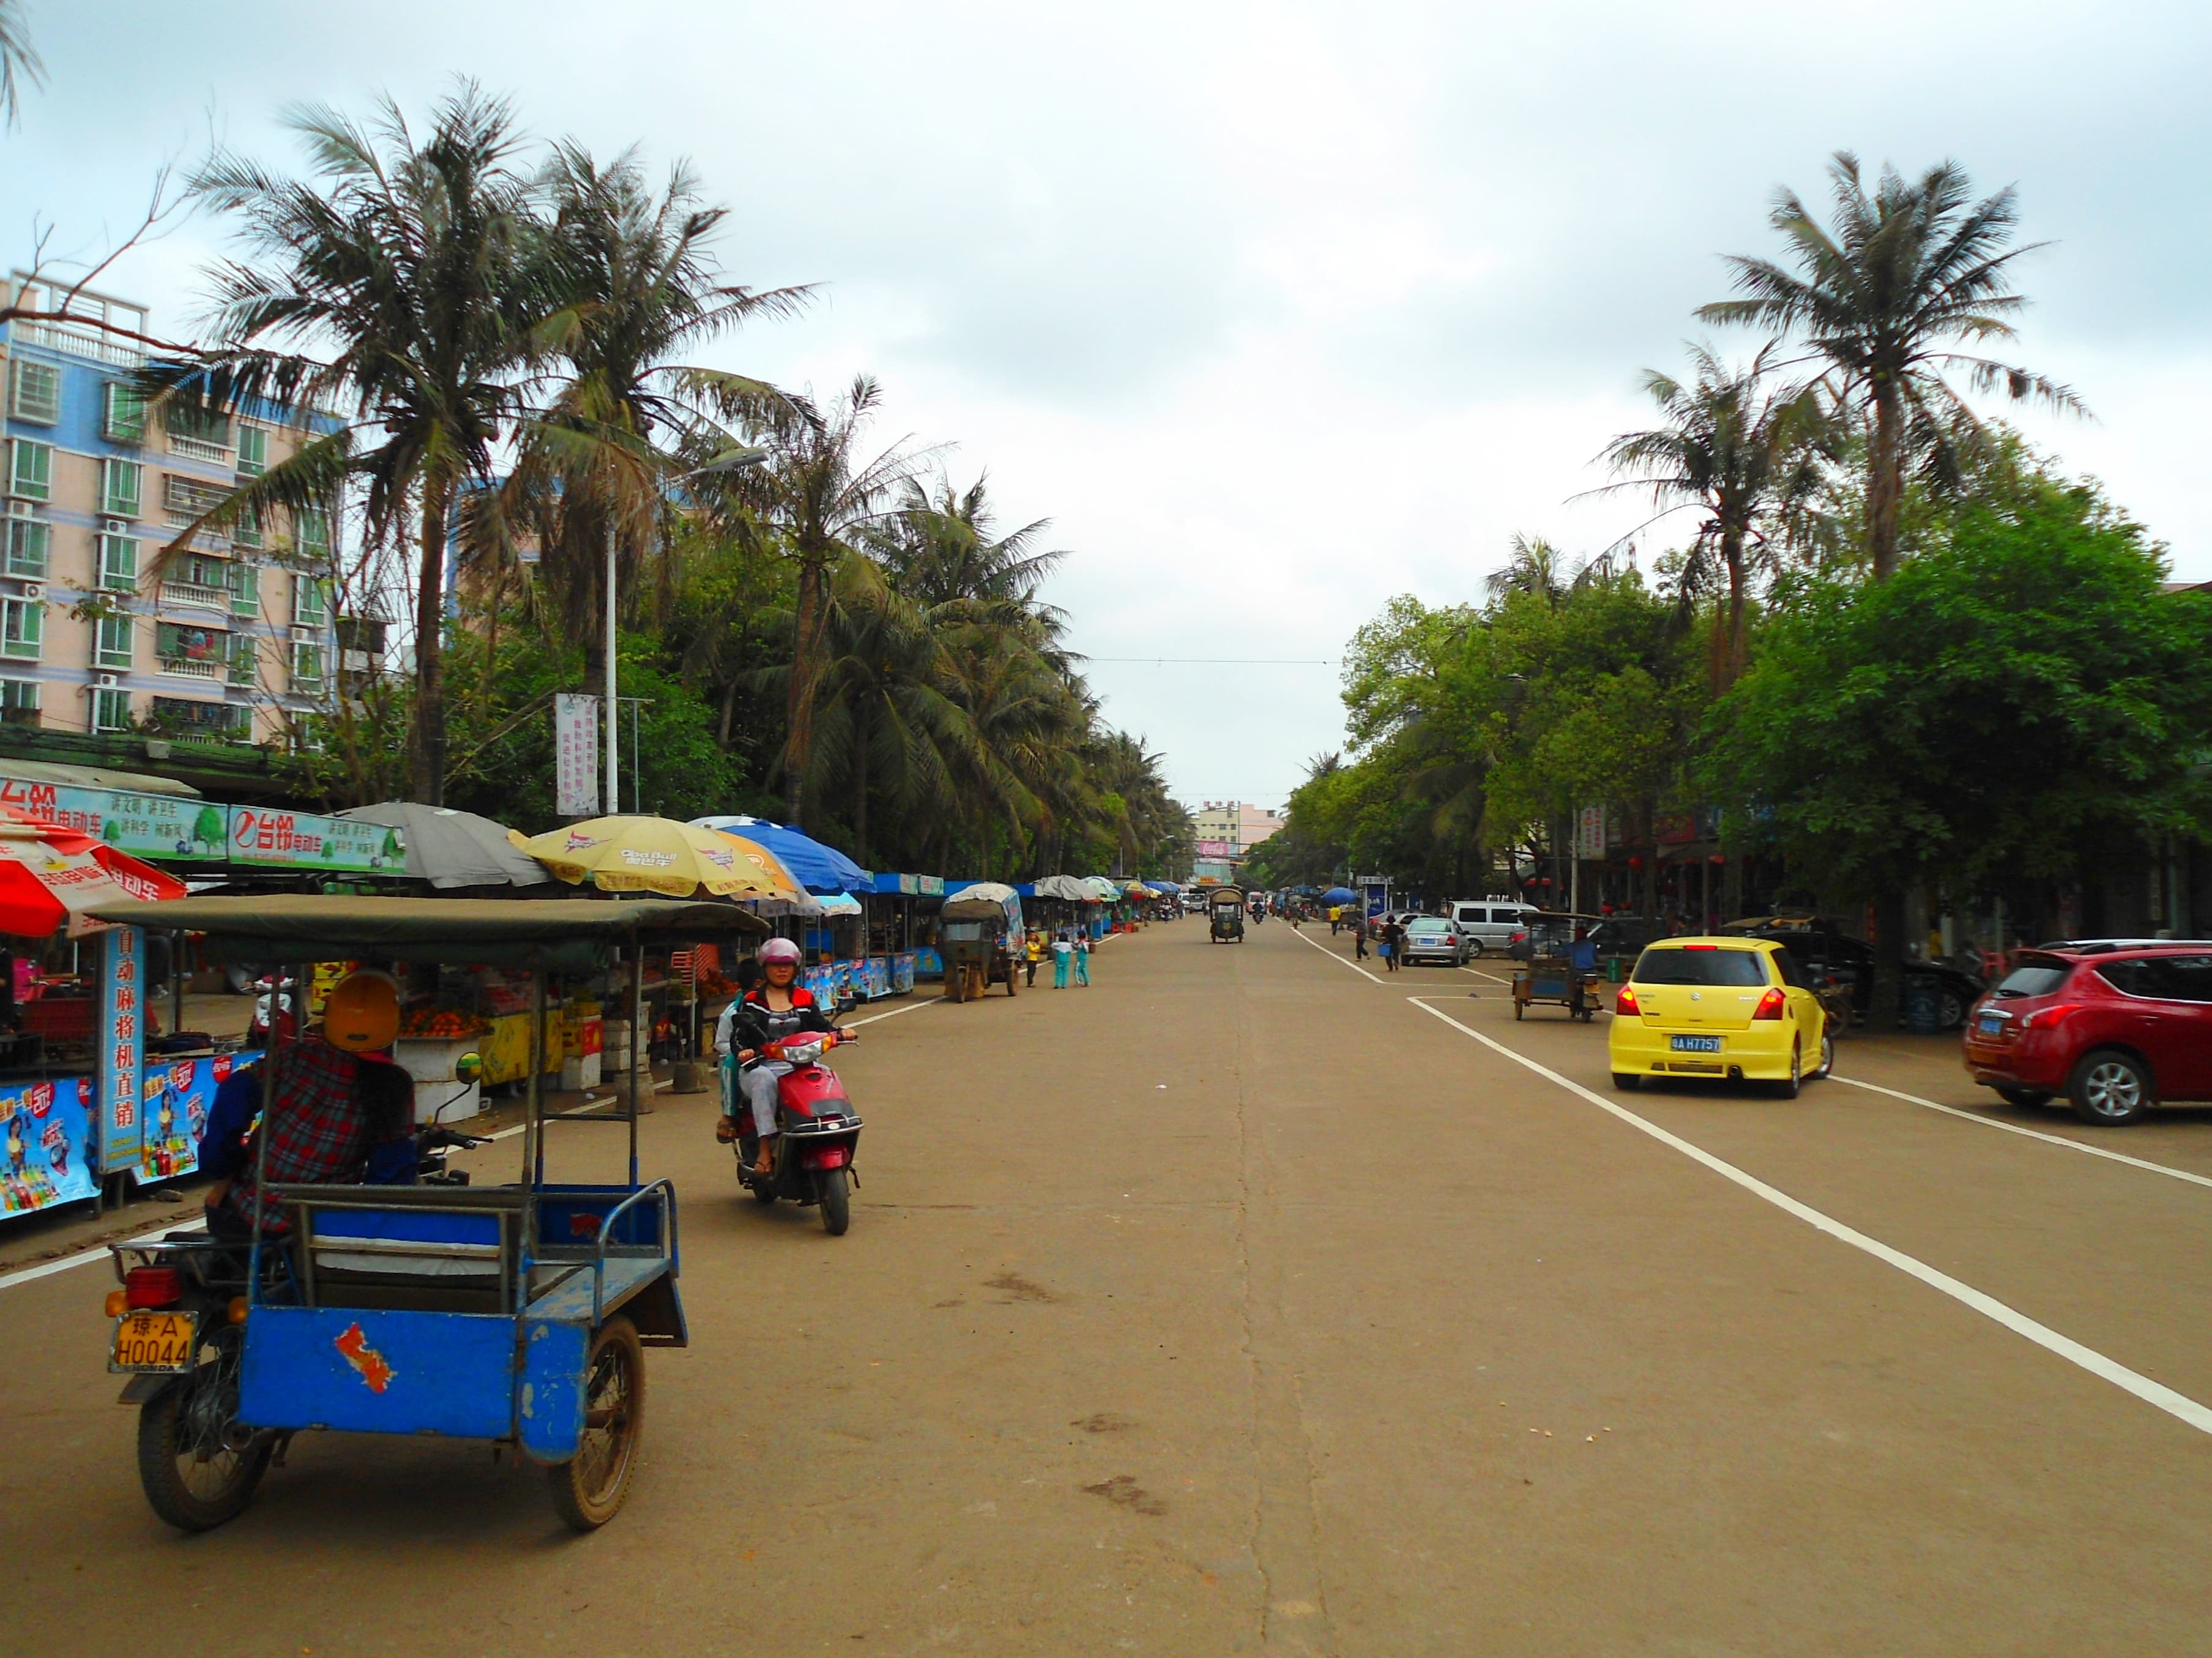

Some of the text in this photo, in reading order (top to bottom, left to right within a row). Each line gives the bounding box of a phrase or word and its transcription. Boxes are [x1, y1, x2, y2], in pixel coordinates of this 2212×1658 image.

[257, 813, 322, 853] 台铃 电动车
[115, 929, 135, 1128] 自动麻将机直销
[1686, 1038, 1719, 1050] H7757
[117, 1340, 188, 1364] H0044
